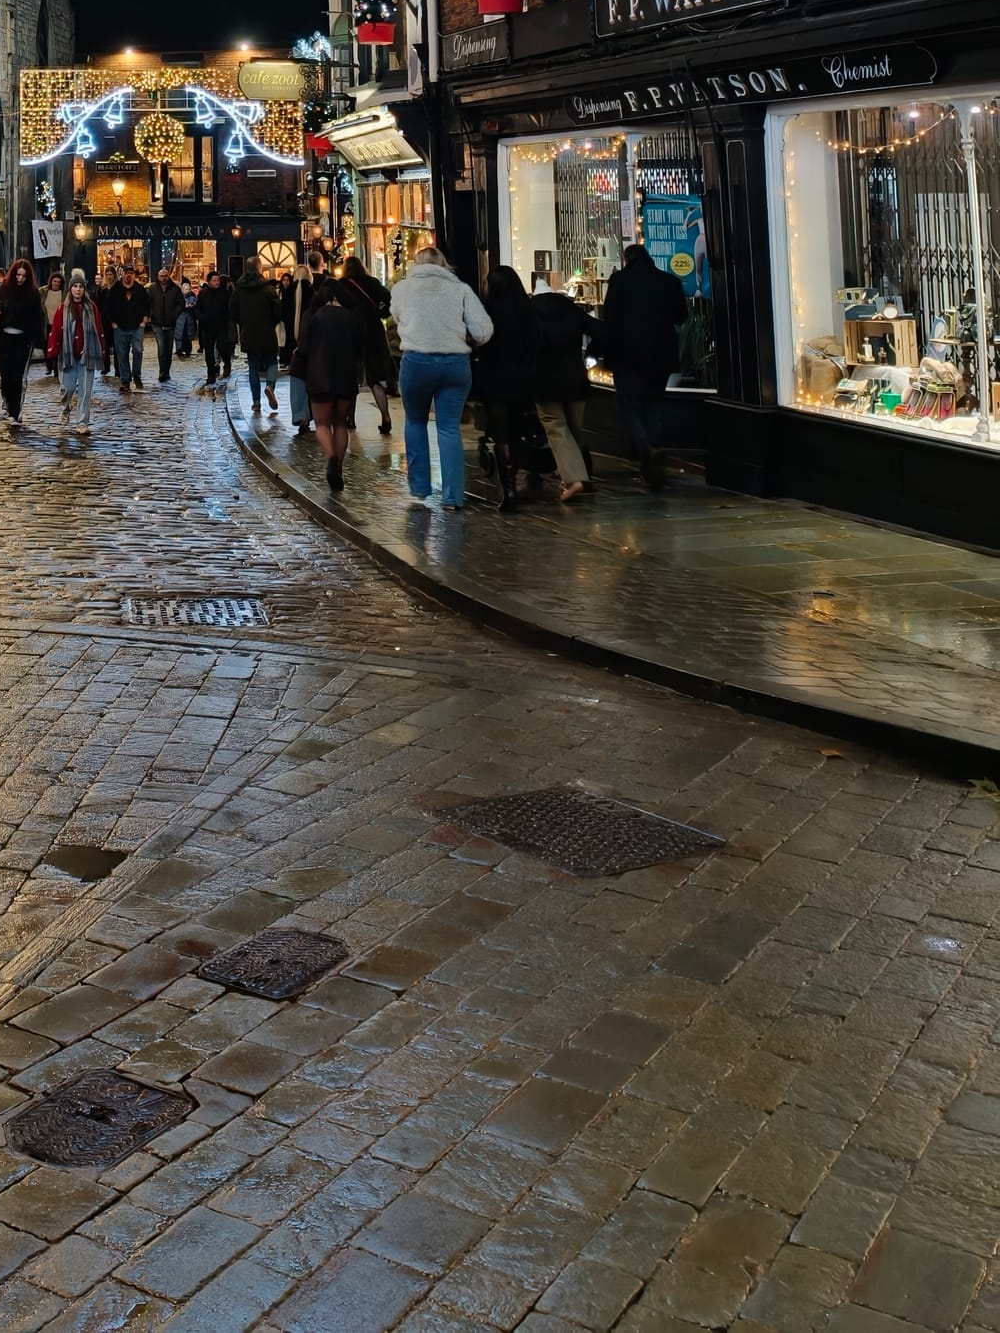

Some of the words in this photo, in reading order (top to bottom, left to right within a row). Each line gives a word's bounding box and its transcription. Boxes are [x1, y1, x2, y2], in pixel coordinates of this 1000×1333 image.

[453, 33, 497, 63] Dispensing
[243, 71, 268, 85] cafe
[271, 73, 299, 86] zoot
[573, 96, 623, 122] Dispensing
[821, 53, 893, 88] Chemist
[647, 209, 665, 223] START
[668, 209, 684, 223] YOUR
[98, 225, 154, 236] MAGNA
[161, 225, 213, 236] CARTA
[648, 225, 670, 239] WEIGHT
[672, 225, 688, 239] LOSS
